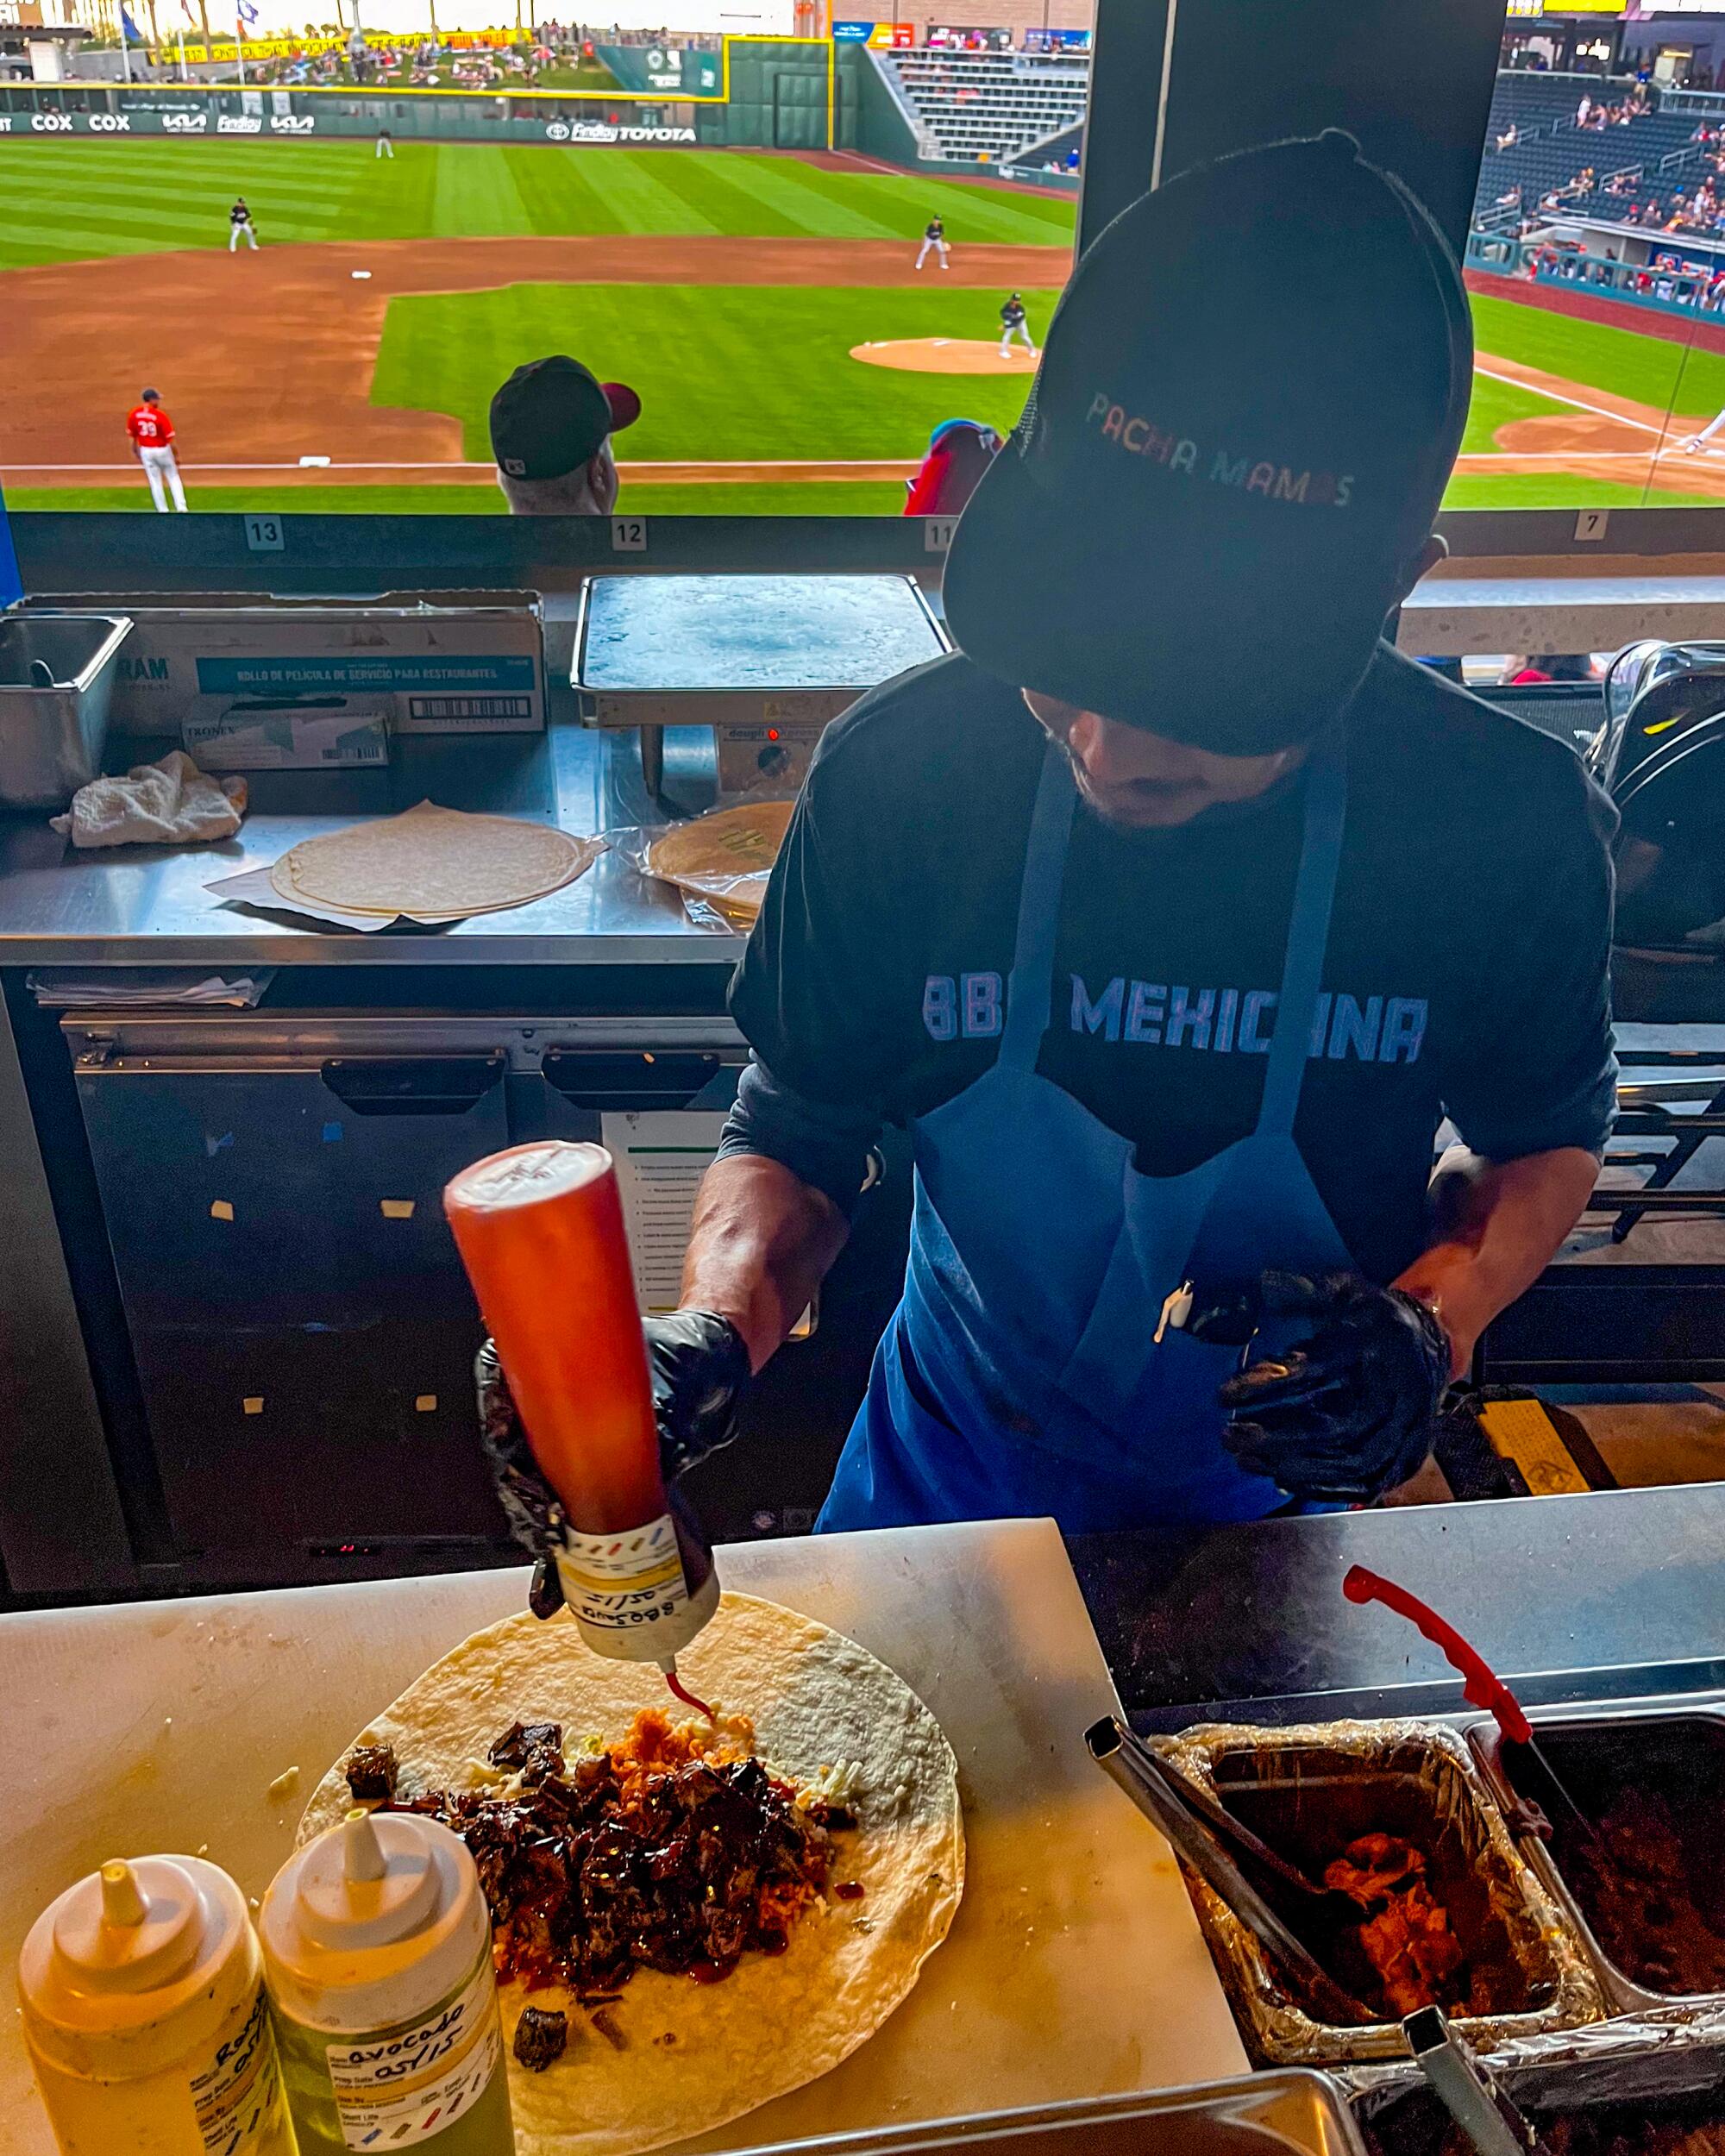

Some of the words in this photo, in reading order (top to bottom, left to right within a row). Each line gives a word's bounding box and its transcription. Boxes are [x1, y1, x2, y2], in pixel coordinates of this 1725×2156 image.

[31, 114, 73, 131] COX
[89, 115, 130, 131] COX
[619, 127, 697, 141] TOYOTA
[1086, 392, 1197, 474] PACHA
[251, 522, 278, 542] 13
[617, 523, 642, 542] 12
[1587, 515, 1599, 532] 7
[931, 524, 951, 545] 11
[270, 669, 284, 681] DE
[333, 669, 347, 681] DE
[348, 669, 393, 680] SERVICIO
[395, 668, 421, 680] PARA
[922, 970, 1004, 1042] BB
[629, 1601, 675, 1622] BBQ
[348, 2003, 466, 2065] avocado
